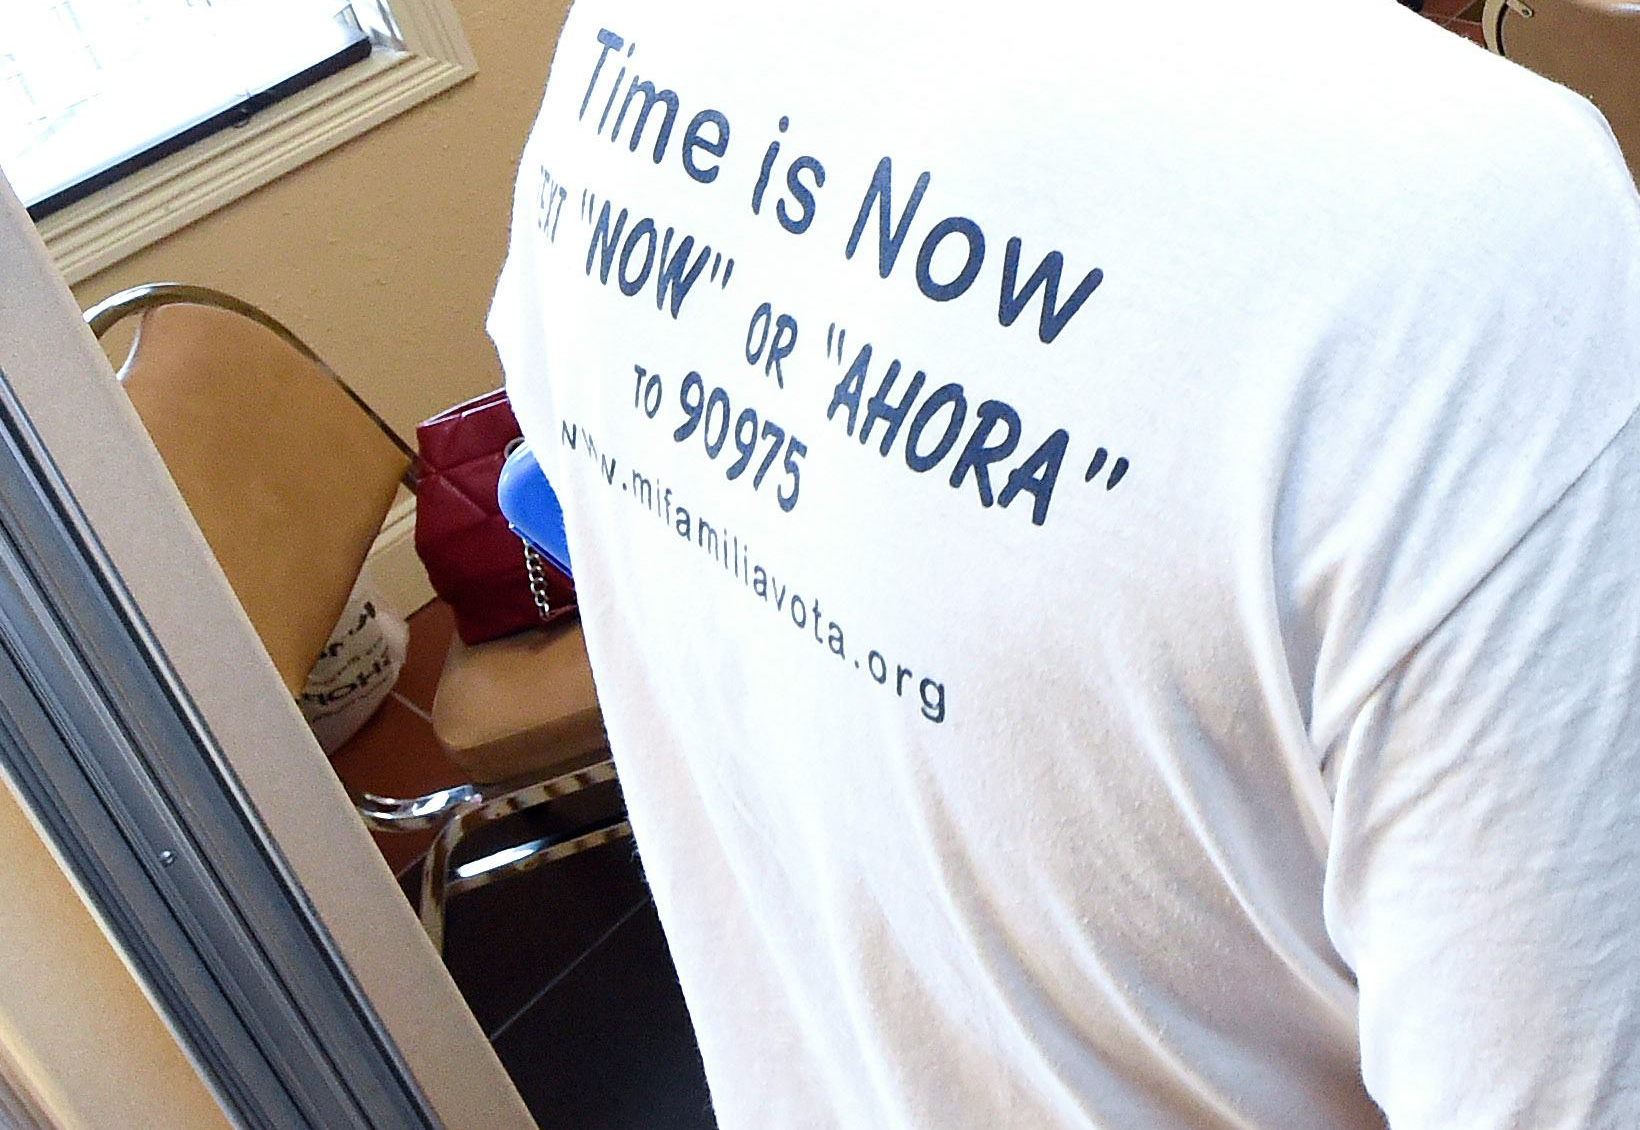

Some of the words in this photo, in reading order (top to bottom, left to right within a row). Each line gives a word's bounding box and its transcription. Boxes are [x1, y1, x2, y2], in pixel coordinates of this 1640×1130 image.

[579, 28, 730, 184] Time
[752, 116, 825, 235] is
[845, 157, 1104, 344] Now
[581, 188, 735, 320] "NOW"
[745, 302, 798, 389] OR
[826, 322, 1130, 526] "AHORA"
[633, 364, 663, 419] TO
[673, 371, 808, 512] 90975
